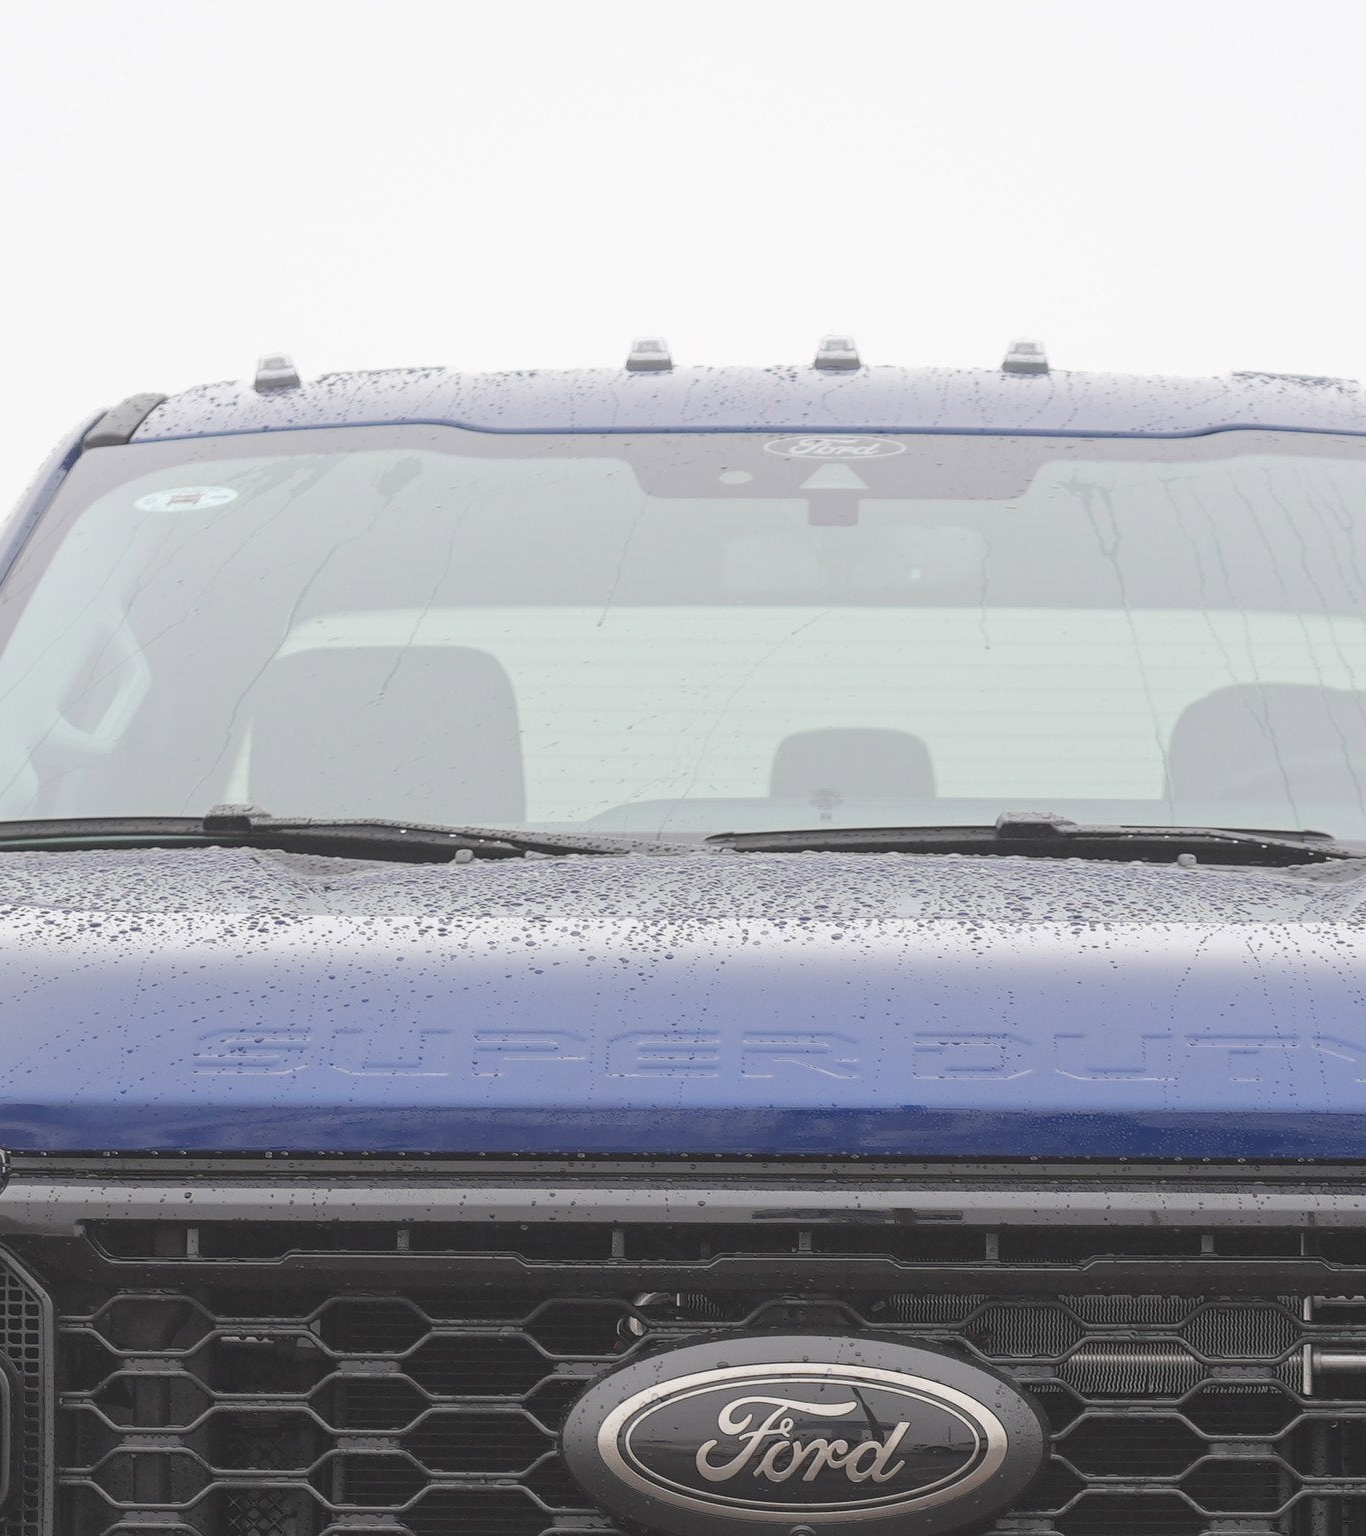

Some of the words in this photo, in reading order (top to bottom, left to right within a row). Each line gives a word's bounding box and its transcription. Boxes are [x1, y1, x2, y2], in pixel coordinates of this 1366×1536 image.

[787, 438, 883, 455] Ford
[191, 1028, 860, 1079] SUPER
[695, 1396, 912, 1482] Ford
